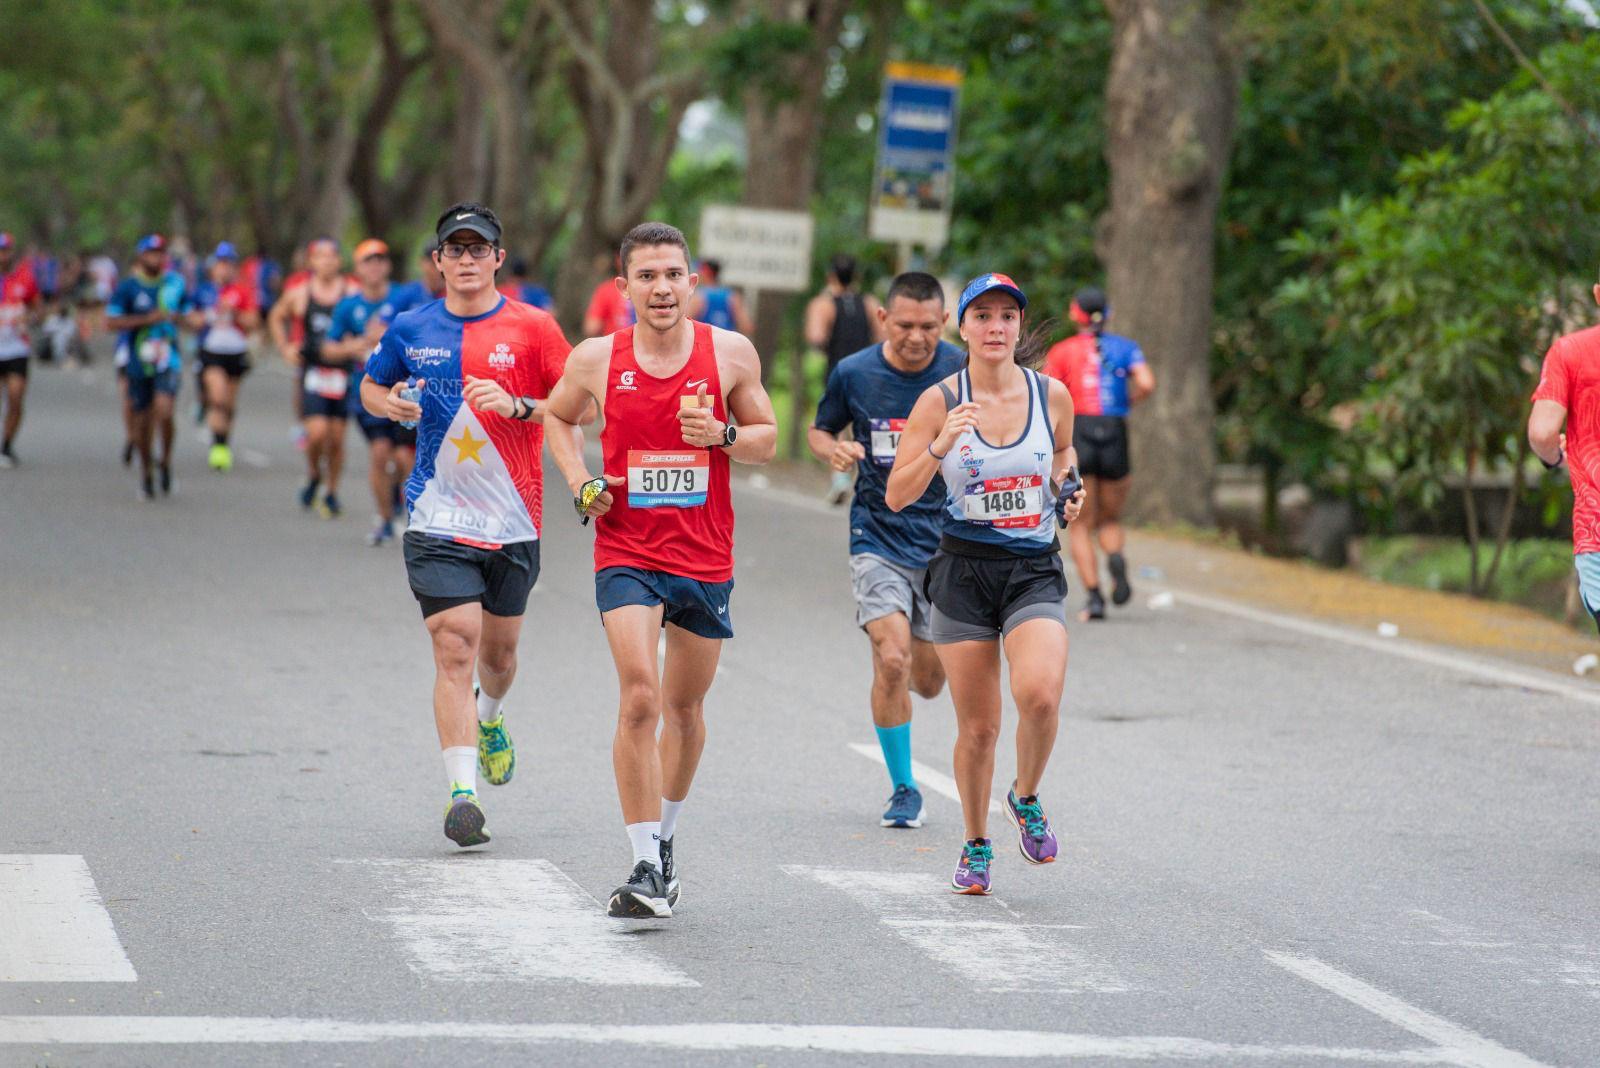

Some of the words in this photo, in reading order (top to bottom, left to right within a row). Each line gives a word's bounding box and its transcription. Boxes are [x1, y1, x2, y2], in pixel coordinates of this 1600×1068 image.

[643, 470, 695, 491] 5079
[1015, 475, 1034, 490] 21K
[981, 490, 1026, 513] 1488
